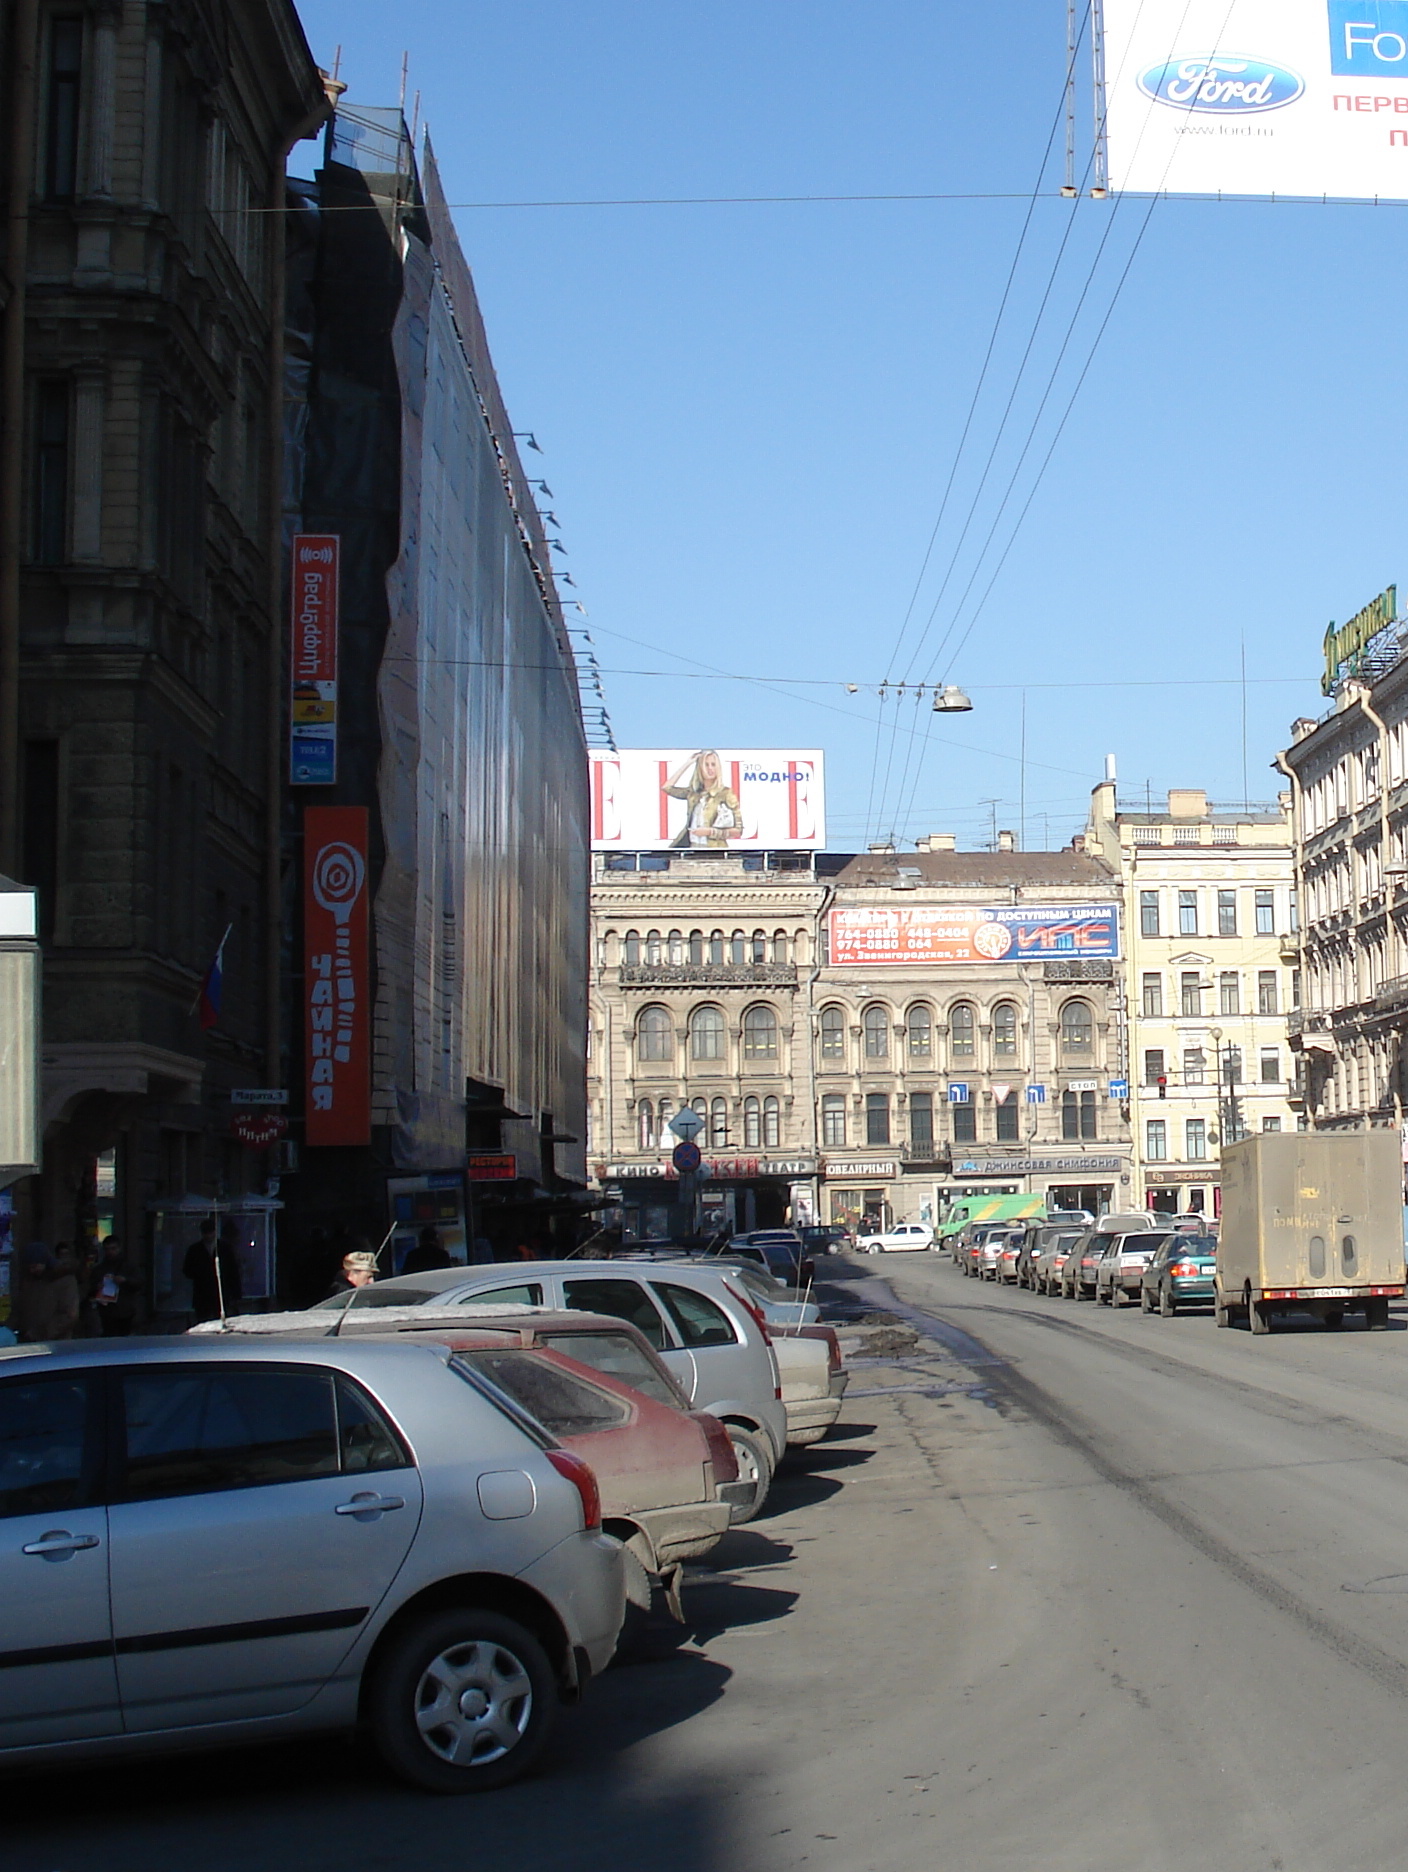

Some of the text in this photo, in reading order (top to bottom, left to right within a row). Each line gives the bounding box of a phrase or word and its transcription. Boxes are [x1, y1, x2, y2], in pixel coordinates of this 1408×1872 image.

[1167, 58, 1273, 105] Ford
[310, 953, 334, 1111] ЧАЙНАЯ
[616, 1164, 659, 1178] КИНО
[825, 1162, 894, 1175] ЮВЕЛИРНЫЙ
